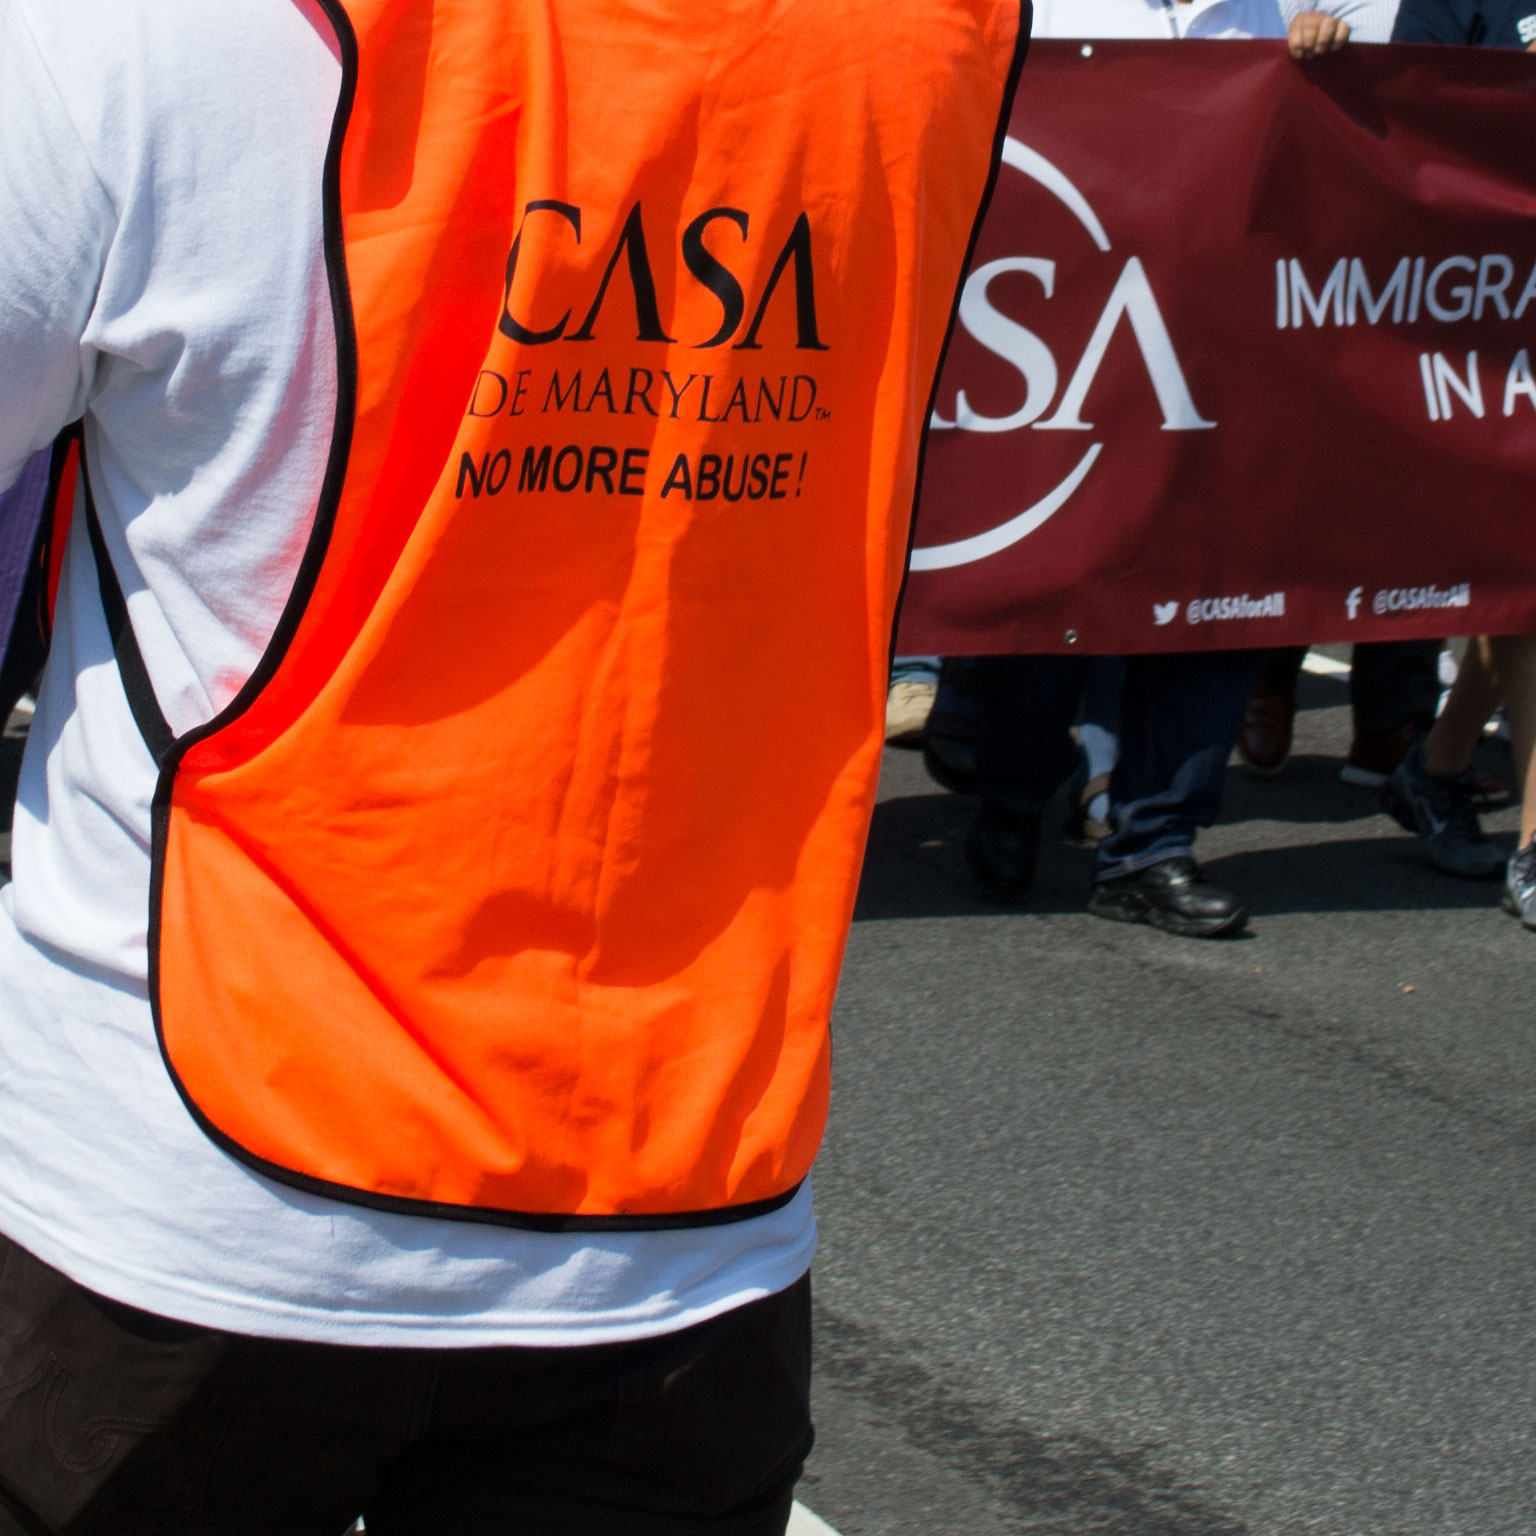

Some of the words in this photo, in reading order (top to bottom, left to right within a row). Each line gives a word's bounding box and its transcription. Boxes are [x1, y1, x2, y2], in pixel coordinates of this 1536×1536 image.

[498, 199, 831, 351] CASA
[927, 255, 1218, 433] SA
[469, 369, 532, 418] DE
[1419, 349, 1485, 422] IN
[455, 448, 511, 499] NO
[517, 444, 650, 495] MORE
[661, 450, 808, 502] ABUSE!
